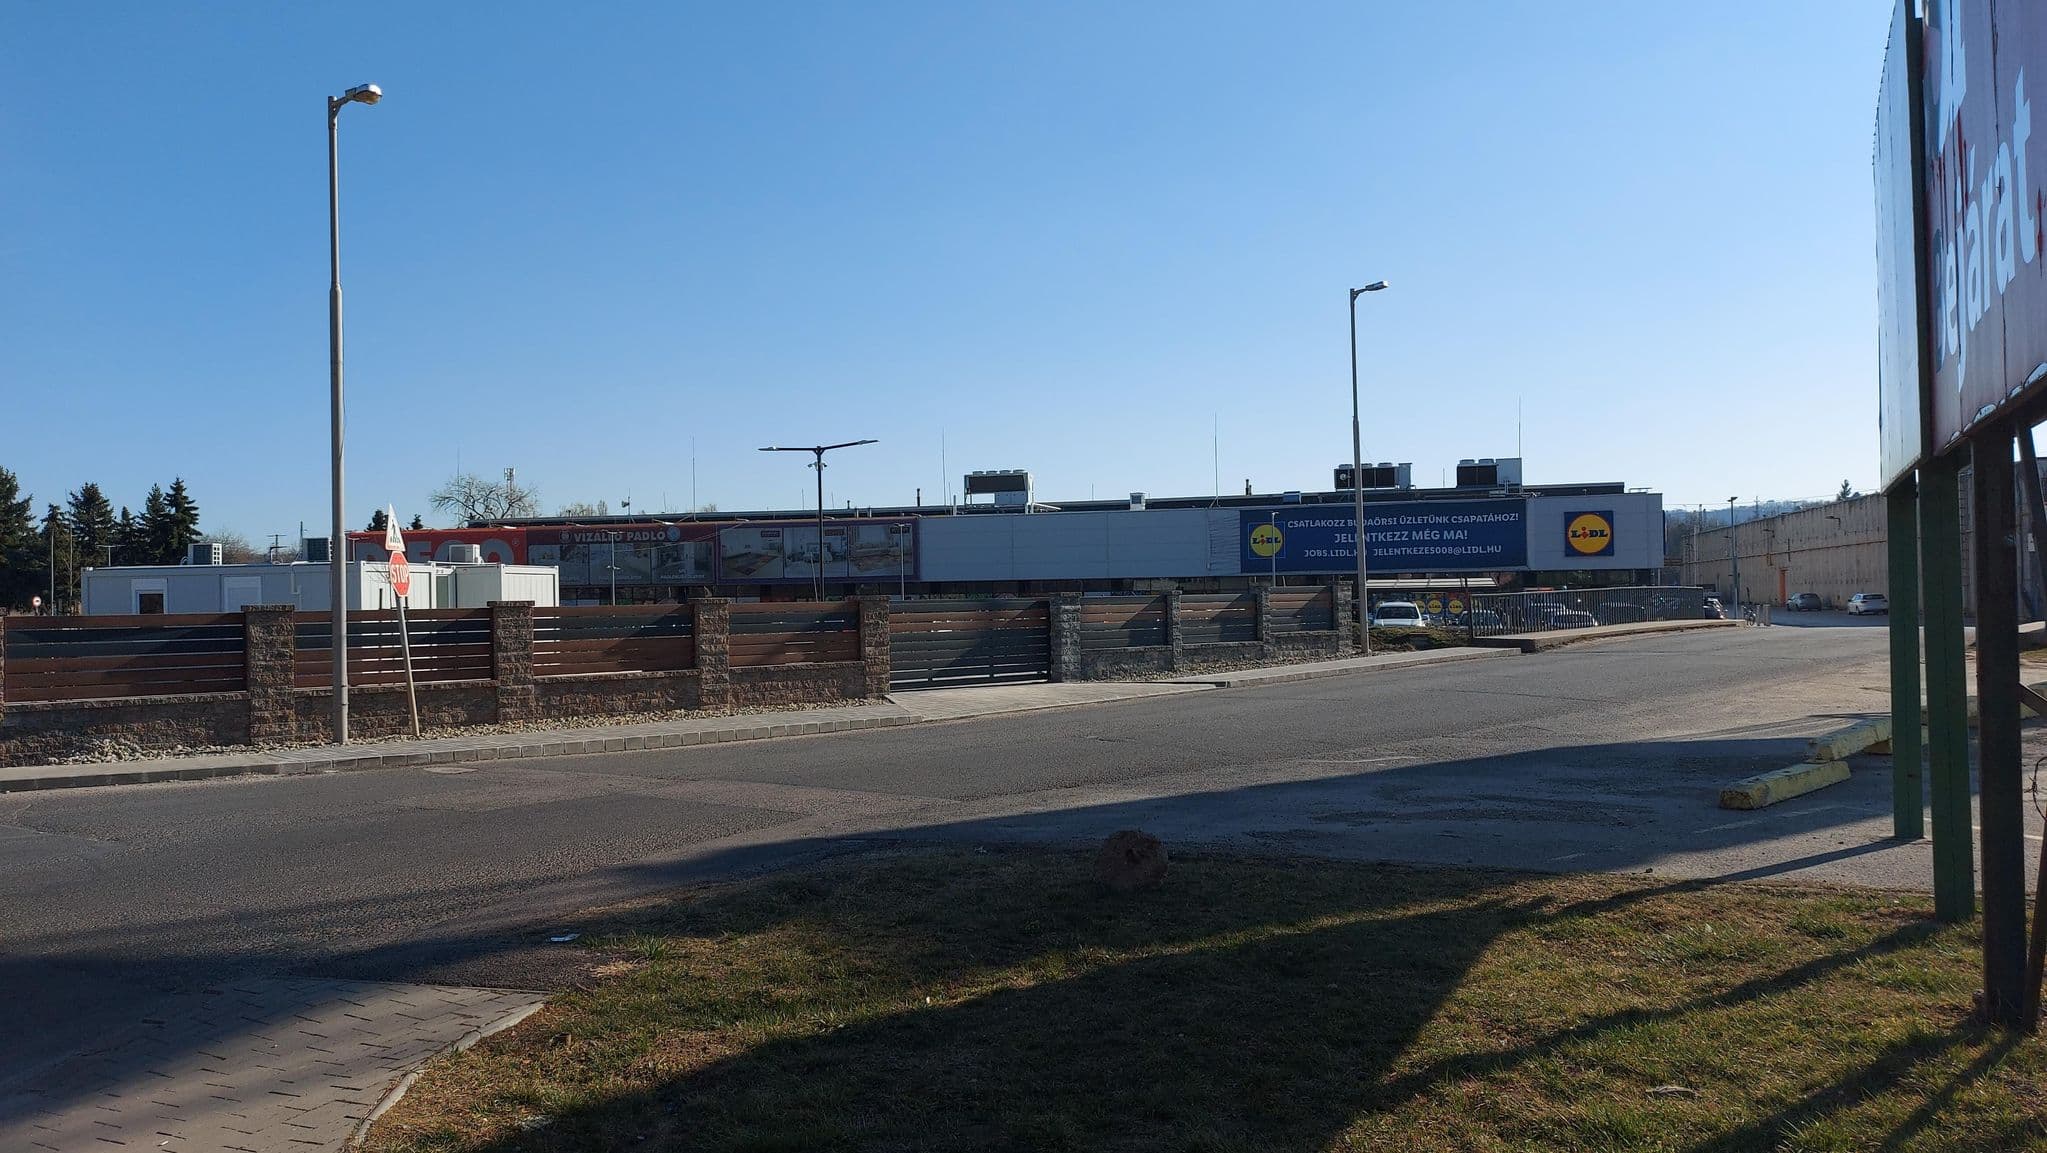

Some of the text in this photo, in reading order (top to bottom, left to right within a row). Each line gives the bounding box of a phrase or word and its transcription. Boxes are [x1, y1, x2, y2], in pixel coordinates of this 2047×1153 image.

[1287, 519, 1346, 529] CSATLAKOZZ
[1451, 513, 1519, 523] CSAPATÁHOZ!
[1412, 529, 1441, 541] MÉG
[1443, 529, 1468, 540] MA!
[390, 564, 409, 584] STOP
